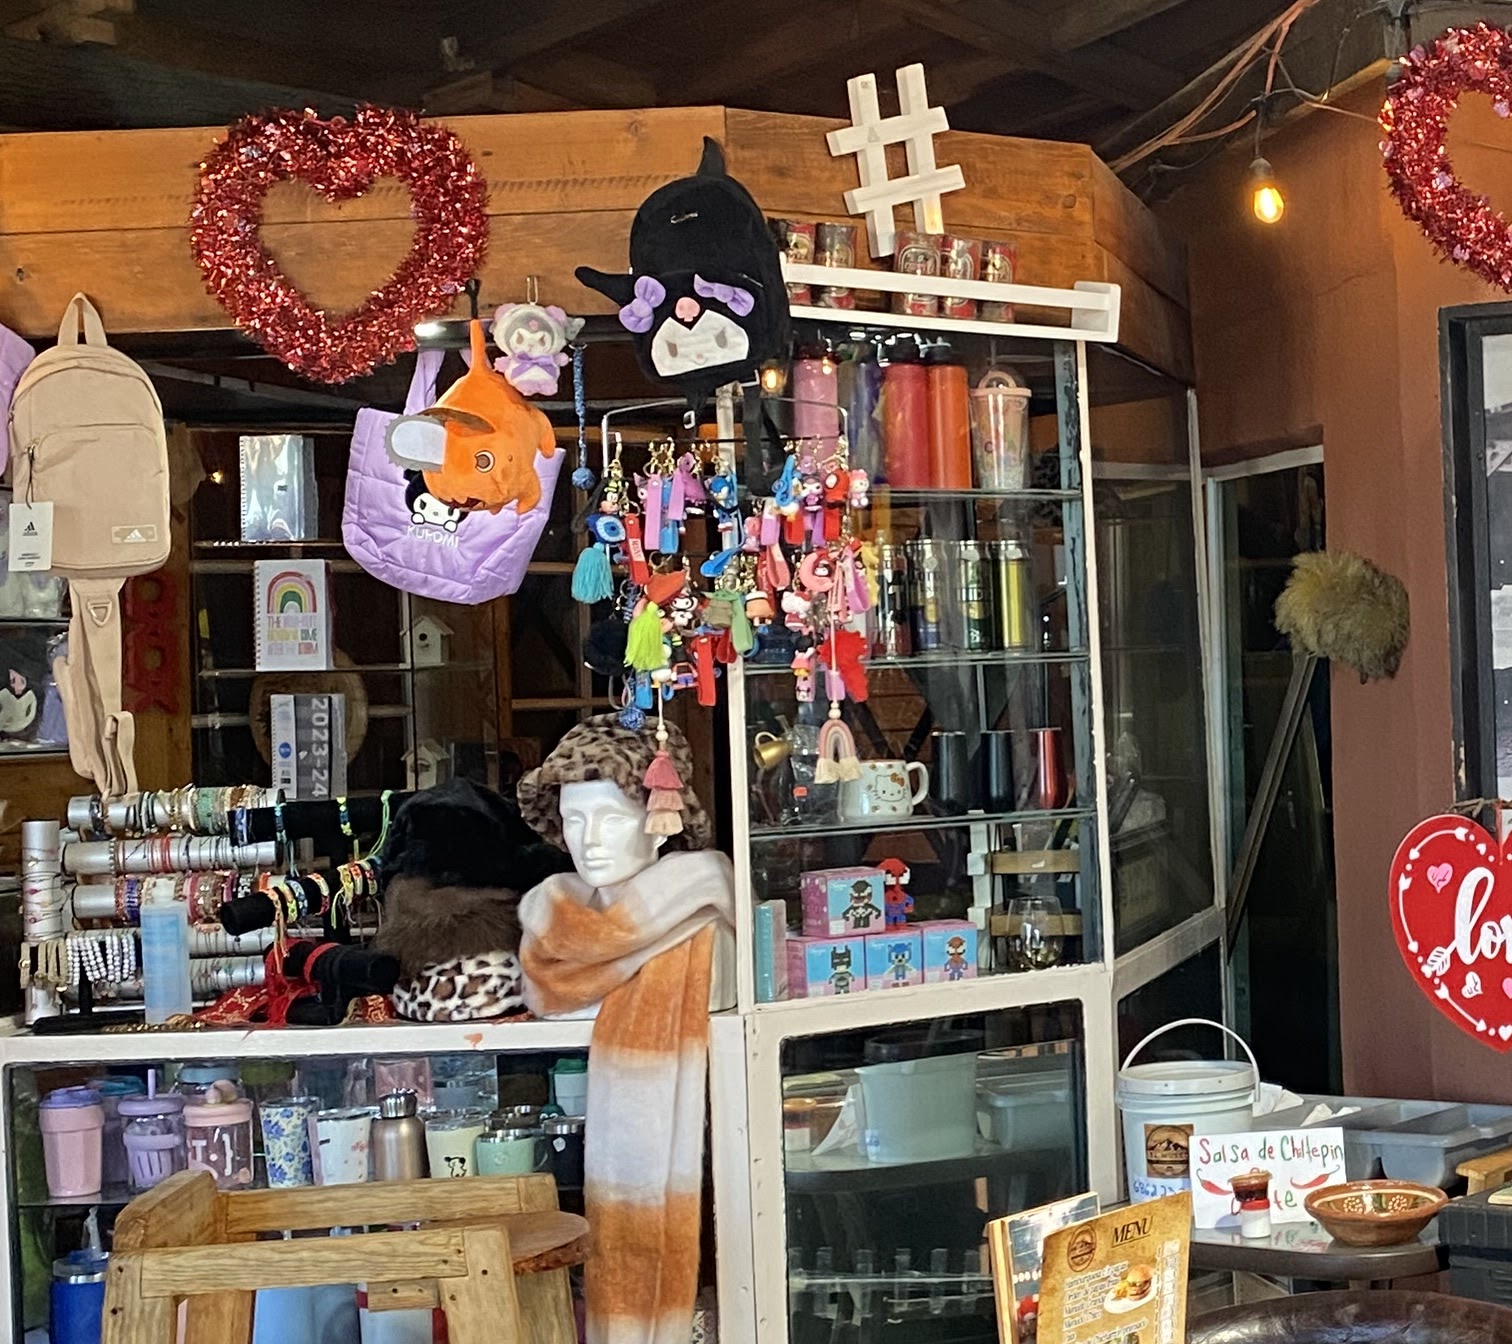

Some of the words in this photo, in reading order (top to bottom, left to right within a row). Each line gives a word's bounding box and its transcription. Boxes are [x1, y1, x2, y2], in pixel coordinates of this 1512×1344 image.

[311, 697, 329, 797] 2023-24
[1199, 1138, 1250, 1165] Salsa
[1258, 1137, 1275, 1161] de
[1280, 1135, 1345, 1167] Chiltepin
[1113, 1215, 1154, 1245] MENU
